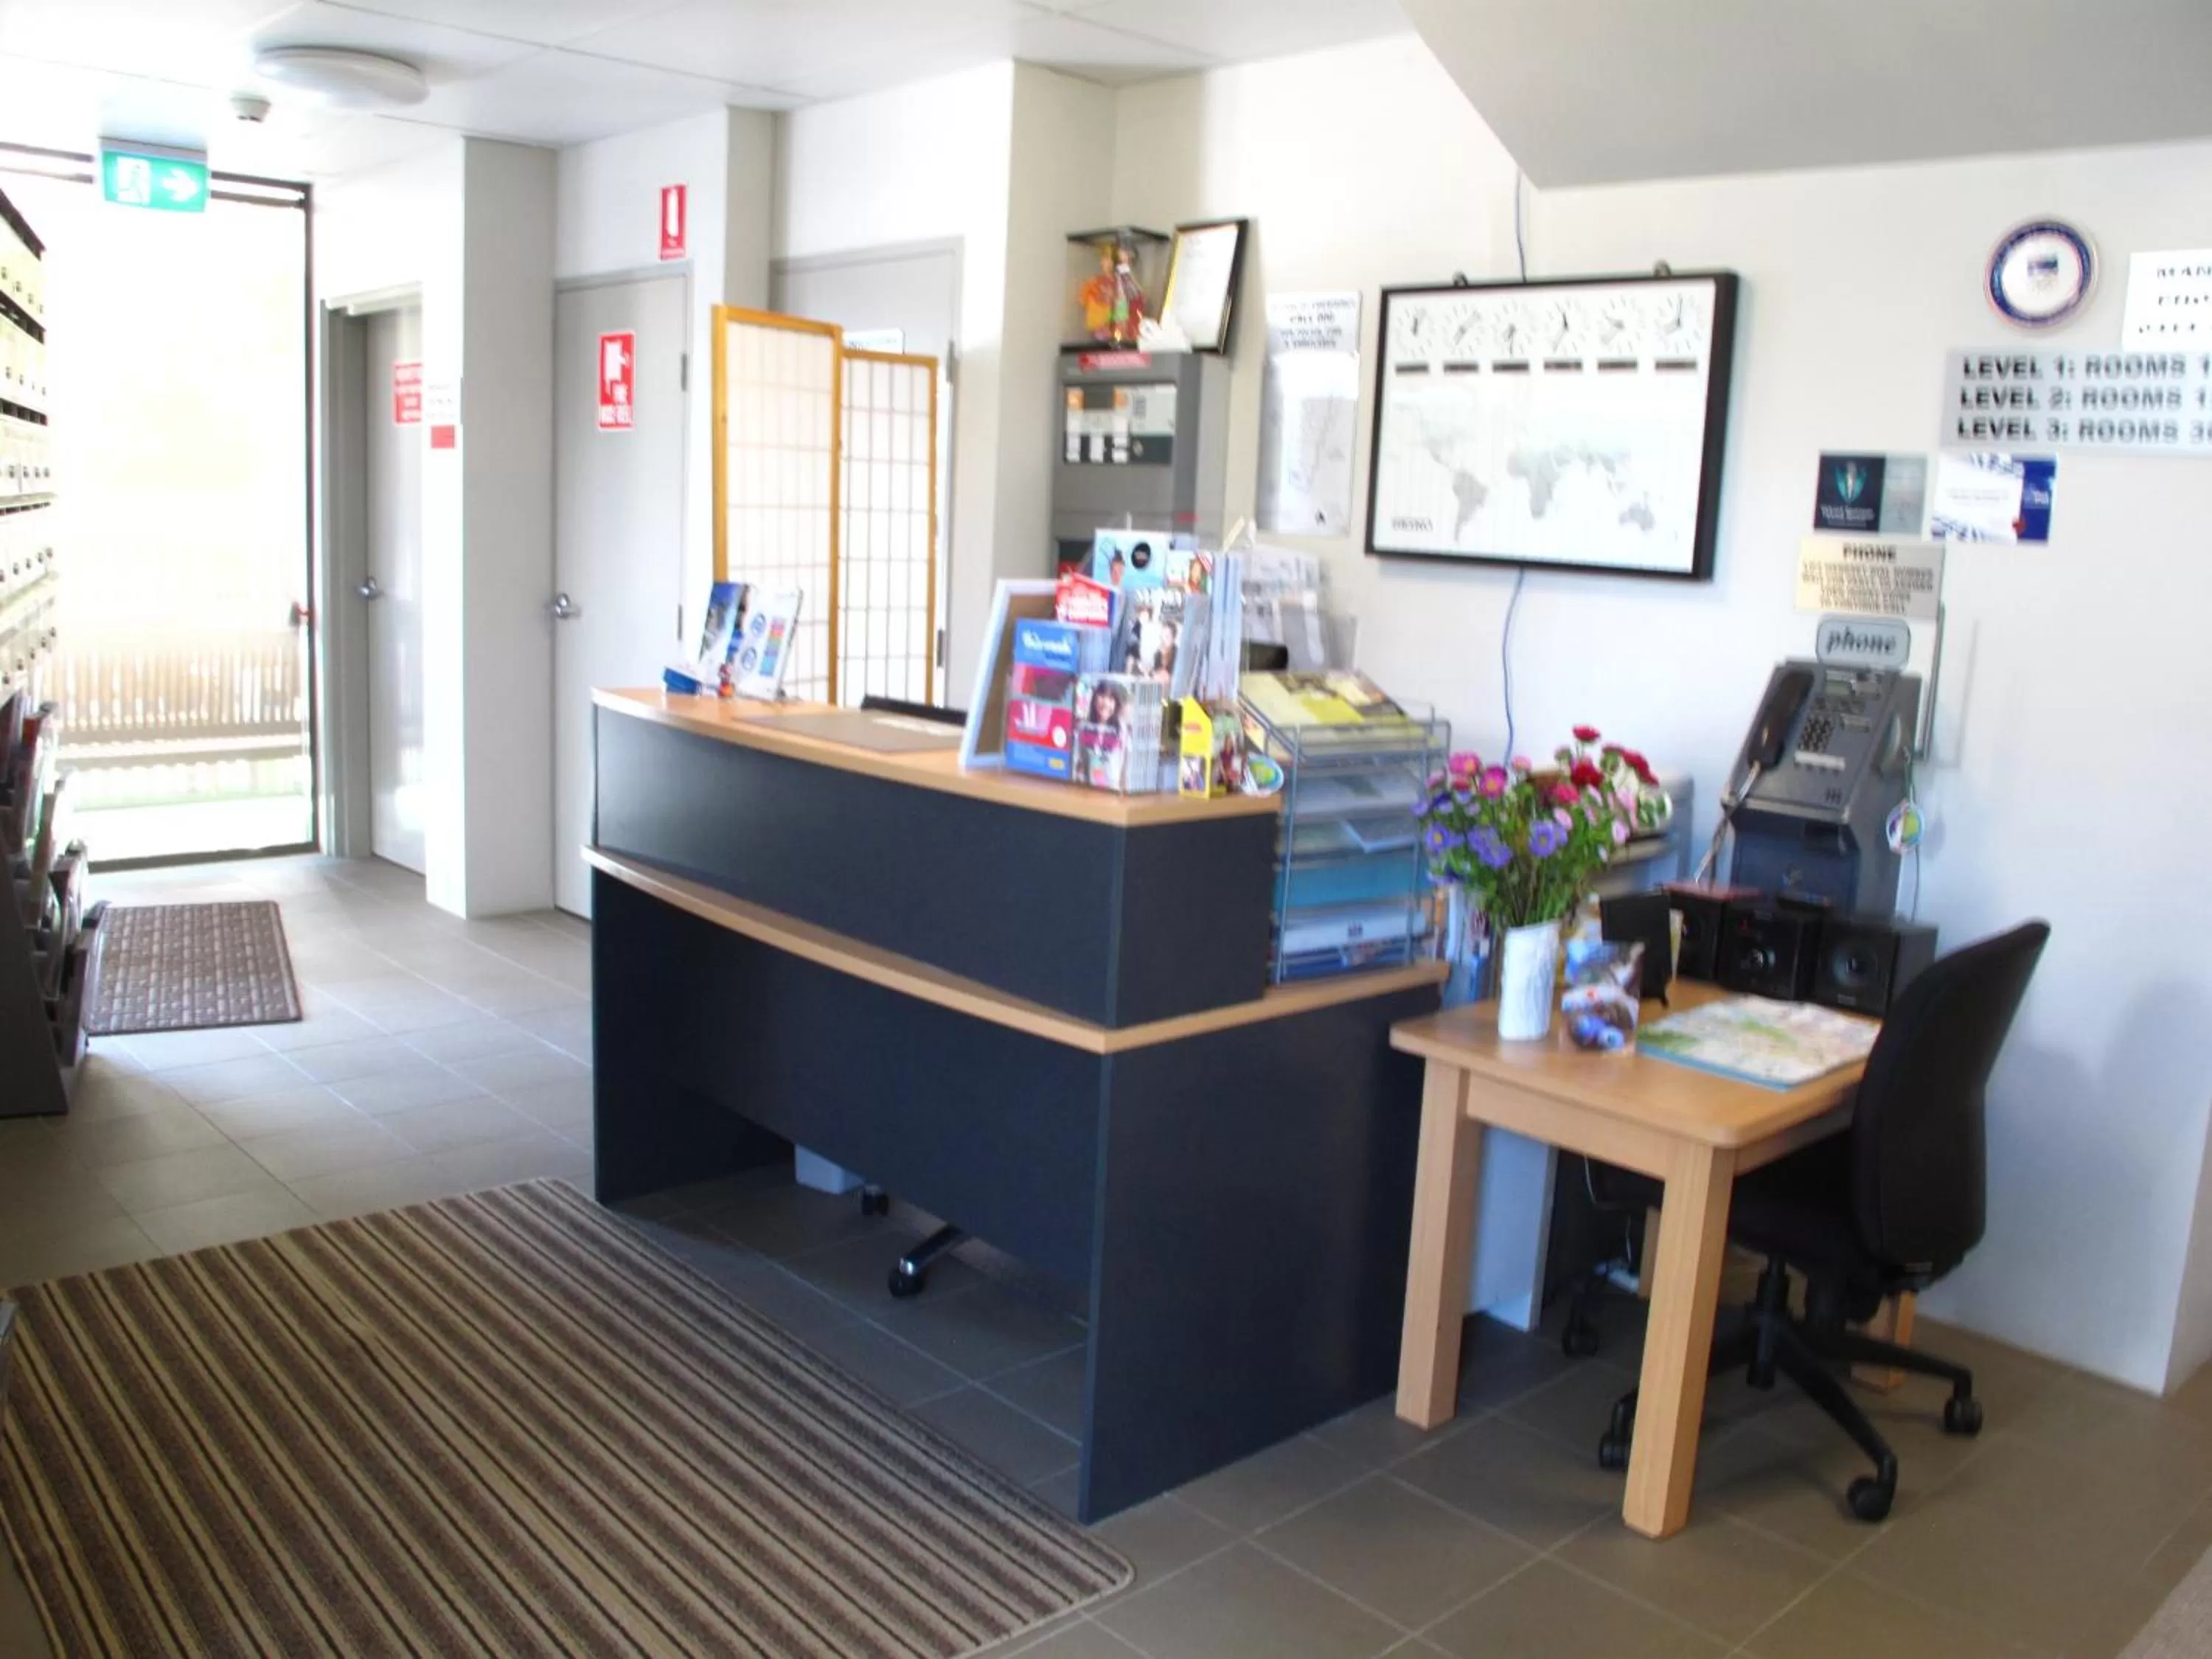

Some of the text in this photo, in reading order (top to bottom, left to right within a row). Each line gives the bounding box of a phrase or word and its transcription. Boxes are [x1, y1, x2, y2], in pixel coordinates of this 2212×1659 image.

[1964, 356, 2044, 380] LEVEL
[2053, 355, 2075, 379] 1:
[2085, 355, 2187, 379] ROOMS
[1960, 386, 2041, 410] LEVEL
[2049, 386, 2071, 410] 2:
[2081, 385, 2183, 410] ROOMS
[1958, 416, 2037, 440] LEVEL
[2046, 417, 2068, 440] 3:
[2078, 417, 2179, 442] ROOMS
[1842, 543, 1897, 562] PHONE
[1826, 625, 1897, 656] phone
